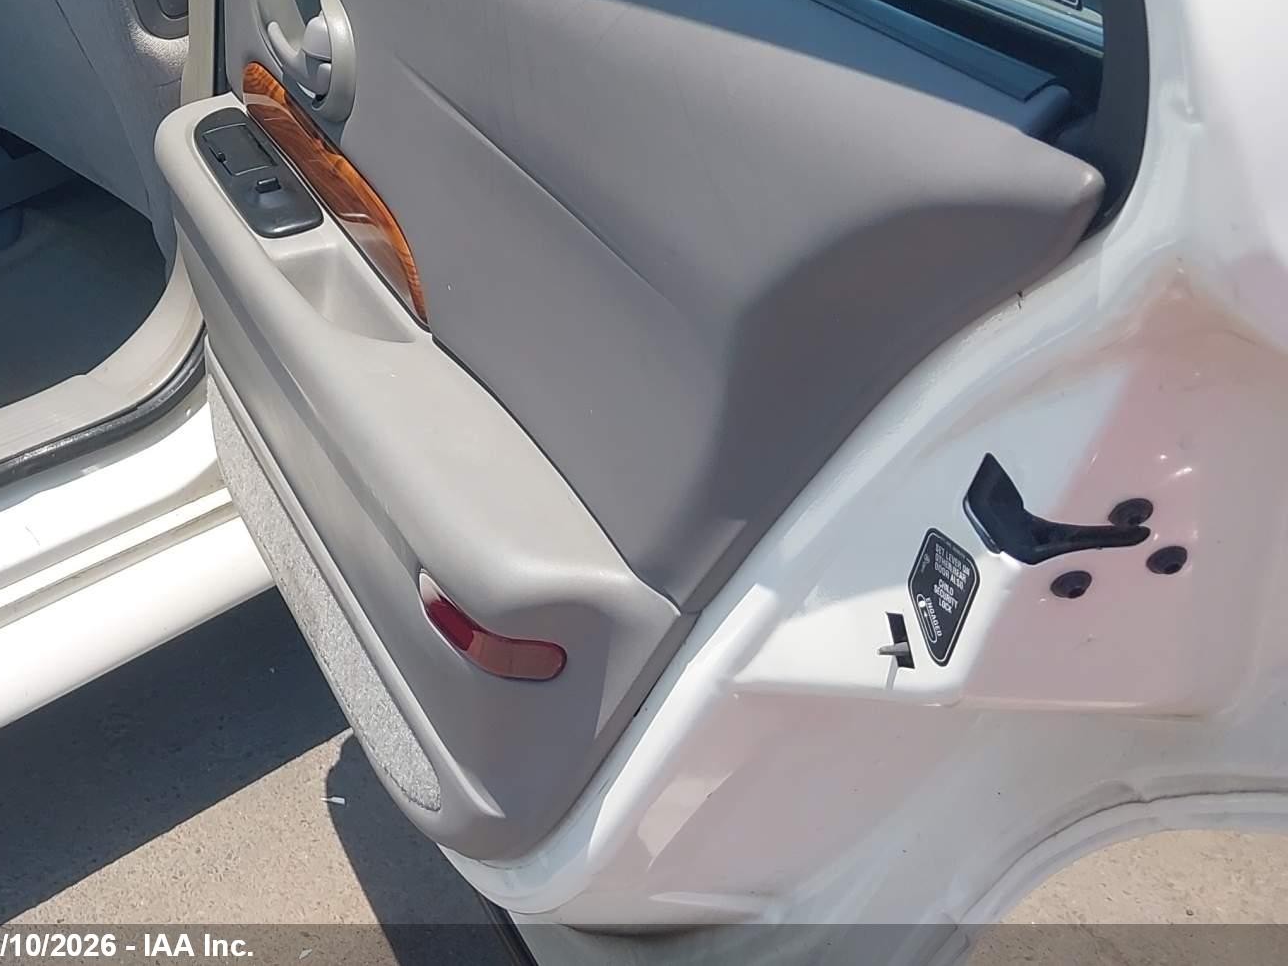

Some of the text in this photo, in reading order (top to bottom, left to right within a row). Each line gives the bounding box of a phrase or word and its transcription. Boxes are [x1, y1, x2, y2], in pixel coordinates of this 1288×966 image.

[933, 584, 959, 609] SECURITY
[938, 578, 954, 596] CHILD
[938, 597, 953, 614] LOCK
[925, 596, 943, 637] ENGAGED
